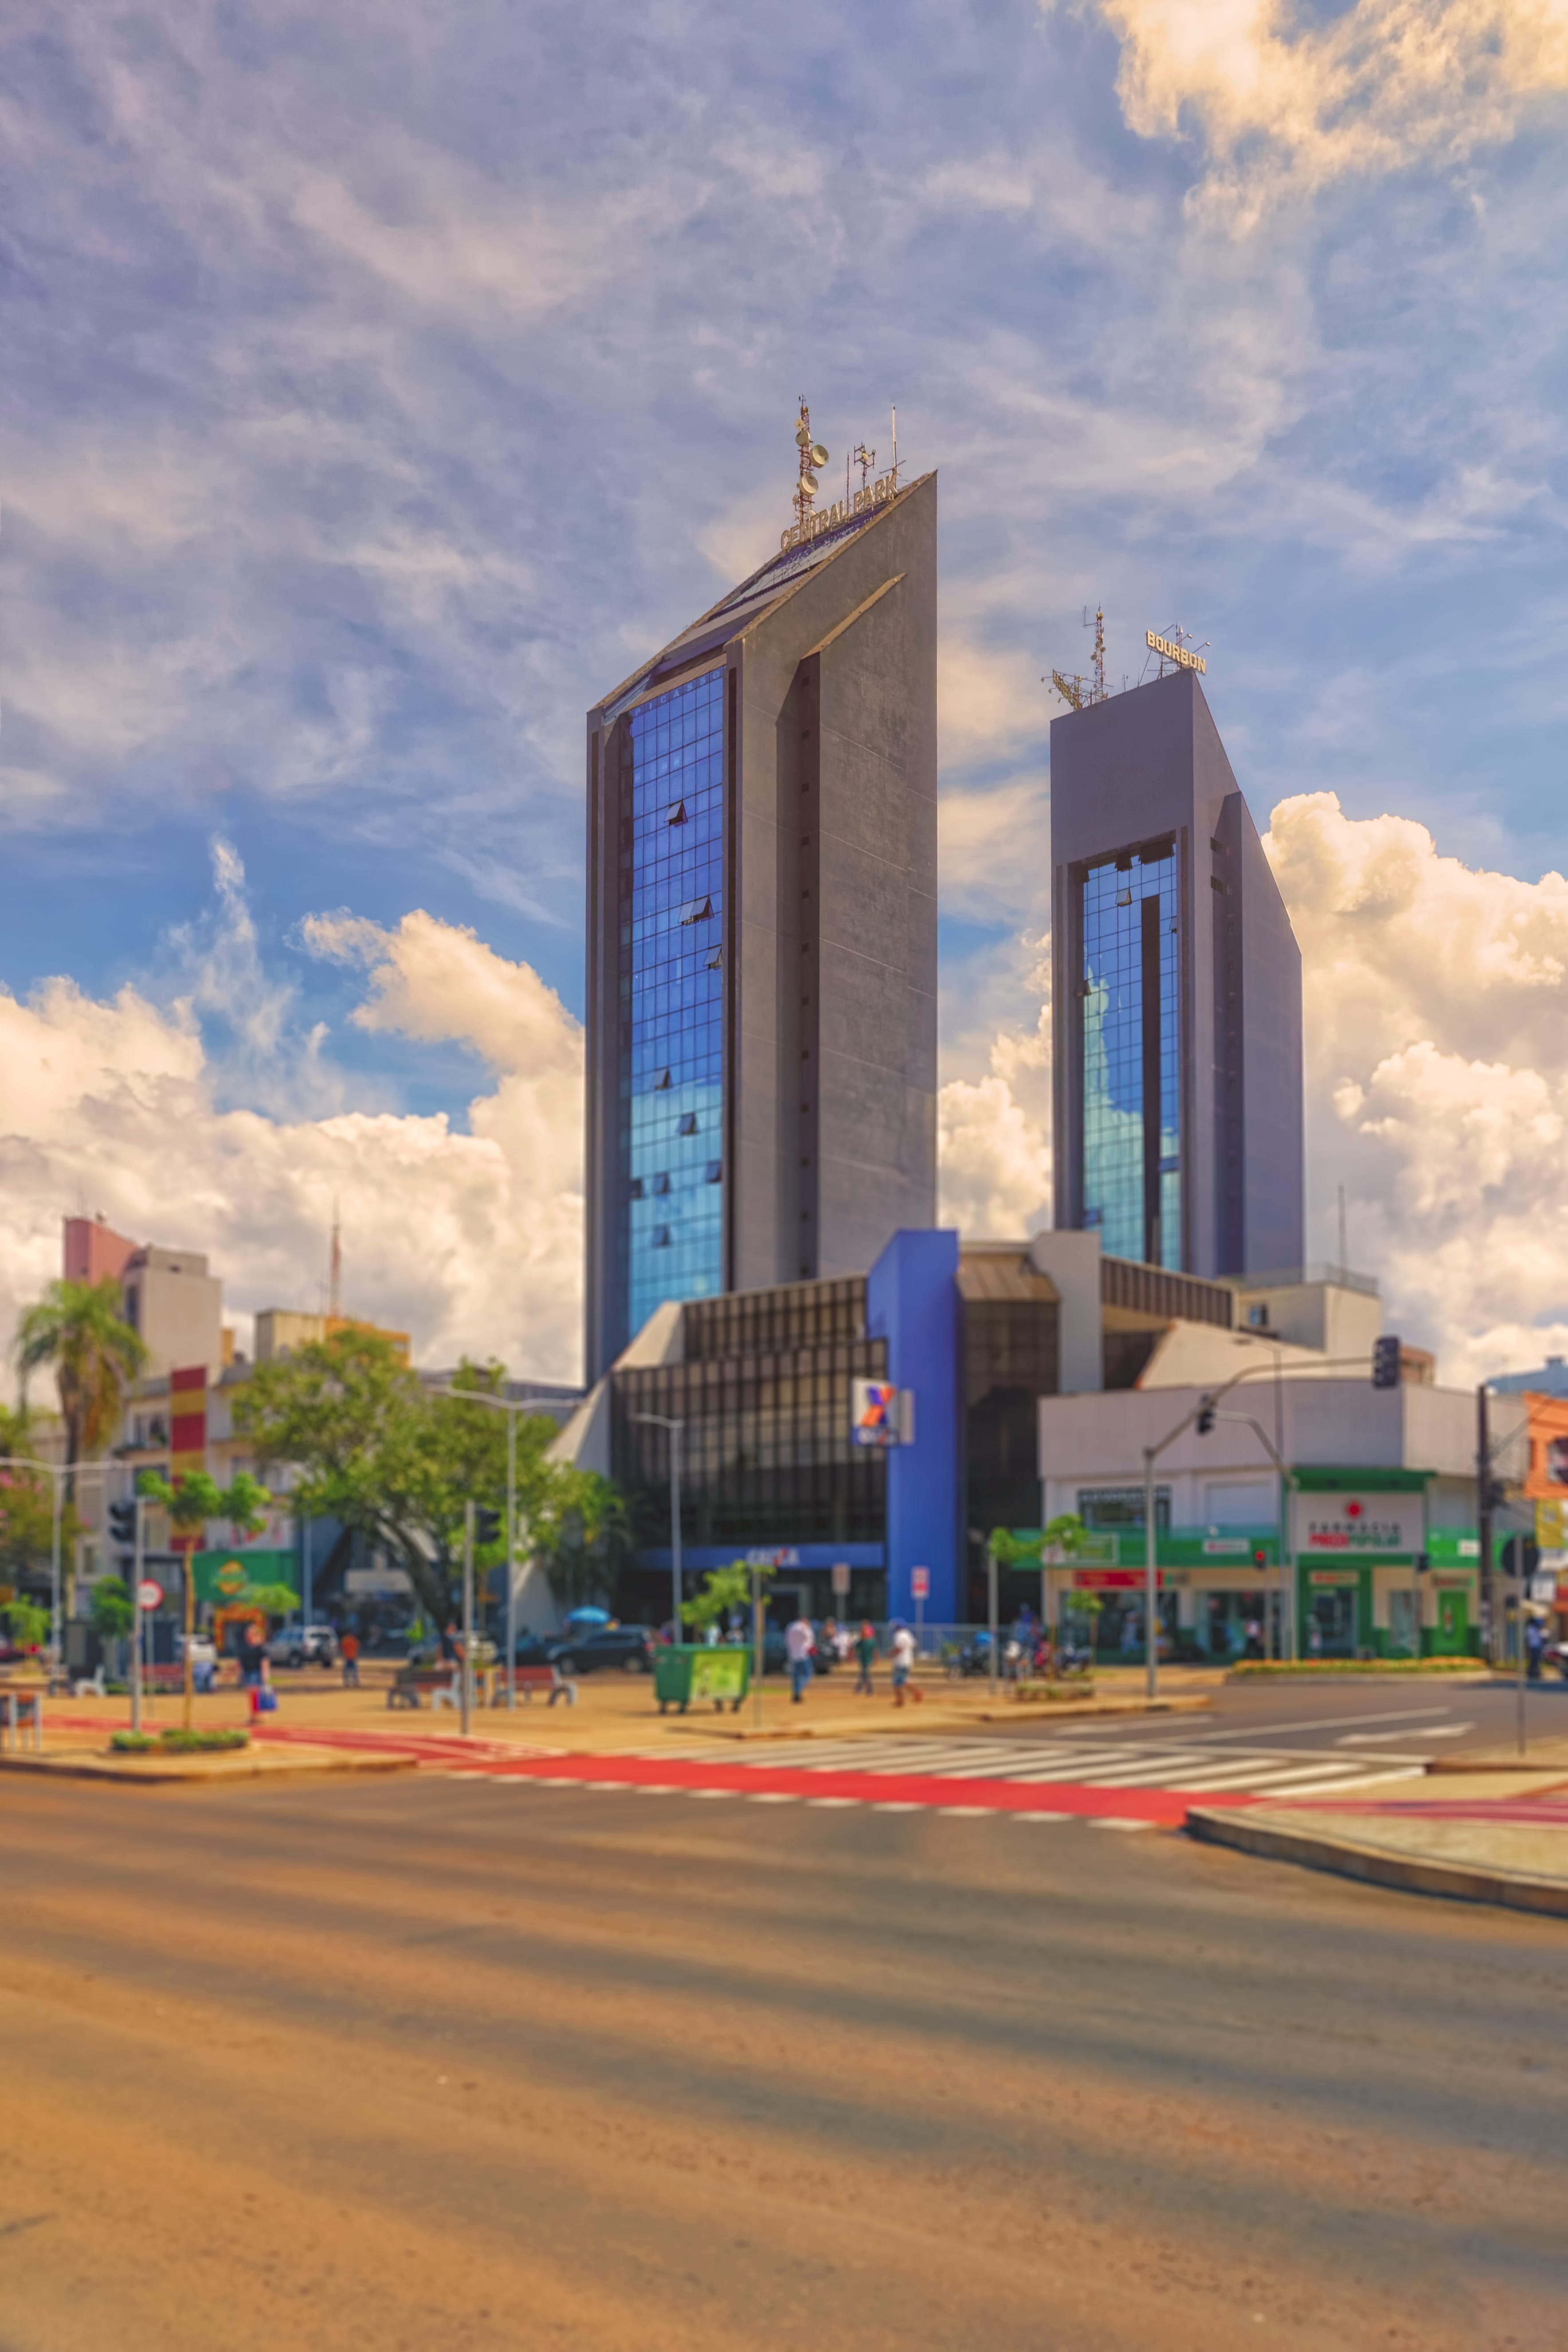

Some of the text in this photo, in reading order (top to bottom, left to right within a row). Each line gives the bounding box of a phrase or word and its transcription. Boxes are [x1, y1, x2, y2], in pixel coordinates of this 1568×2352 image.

[781, 471, 898, 551] CENTRAL PARK
[1147, 629, 1206, 674] BOURBON
[635, 670, 720, 716] PICASSO
